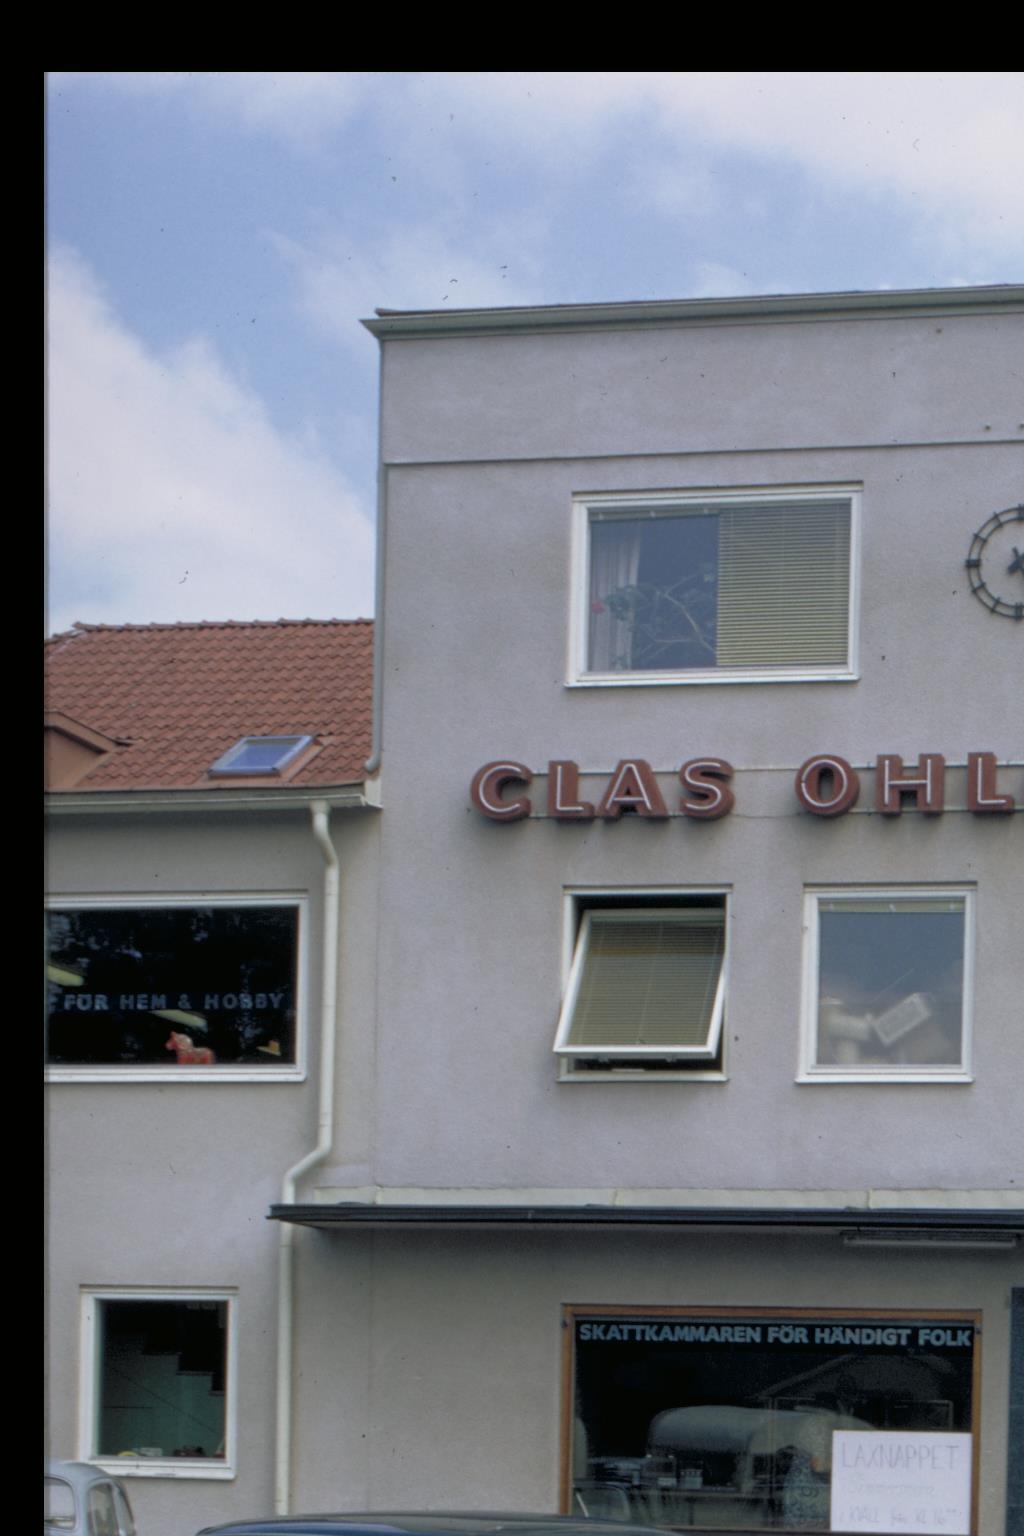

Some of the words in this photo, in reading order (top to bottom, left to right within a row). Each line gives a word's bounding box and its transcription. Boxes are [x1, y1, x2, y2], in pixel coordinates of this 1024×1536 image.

[470, 760, 736, 821] CLAS
[119, 993, 167, 1010] HEM
[177, 993, 193, 1009] &
[204, 993, 285, 1010] HOBBY
[579, 1323, 762, 1344] SKATTKAMMAREN
[767, 1324, 809, 1345] FÖR
[814, 1325, 912, 1346] HÄNDIGT
[917, 1328, 973, 1347] FOLK
[842, 1441, 960, 1470] LAXNAPPET
